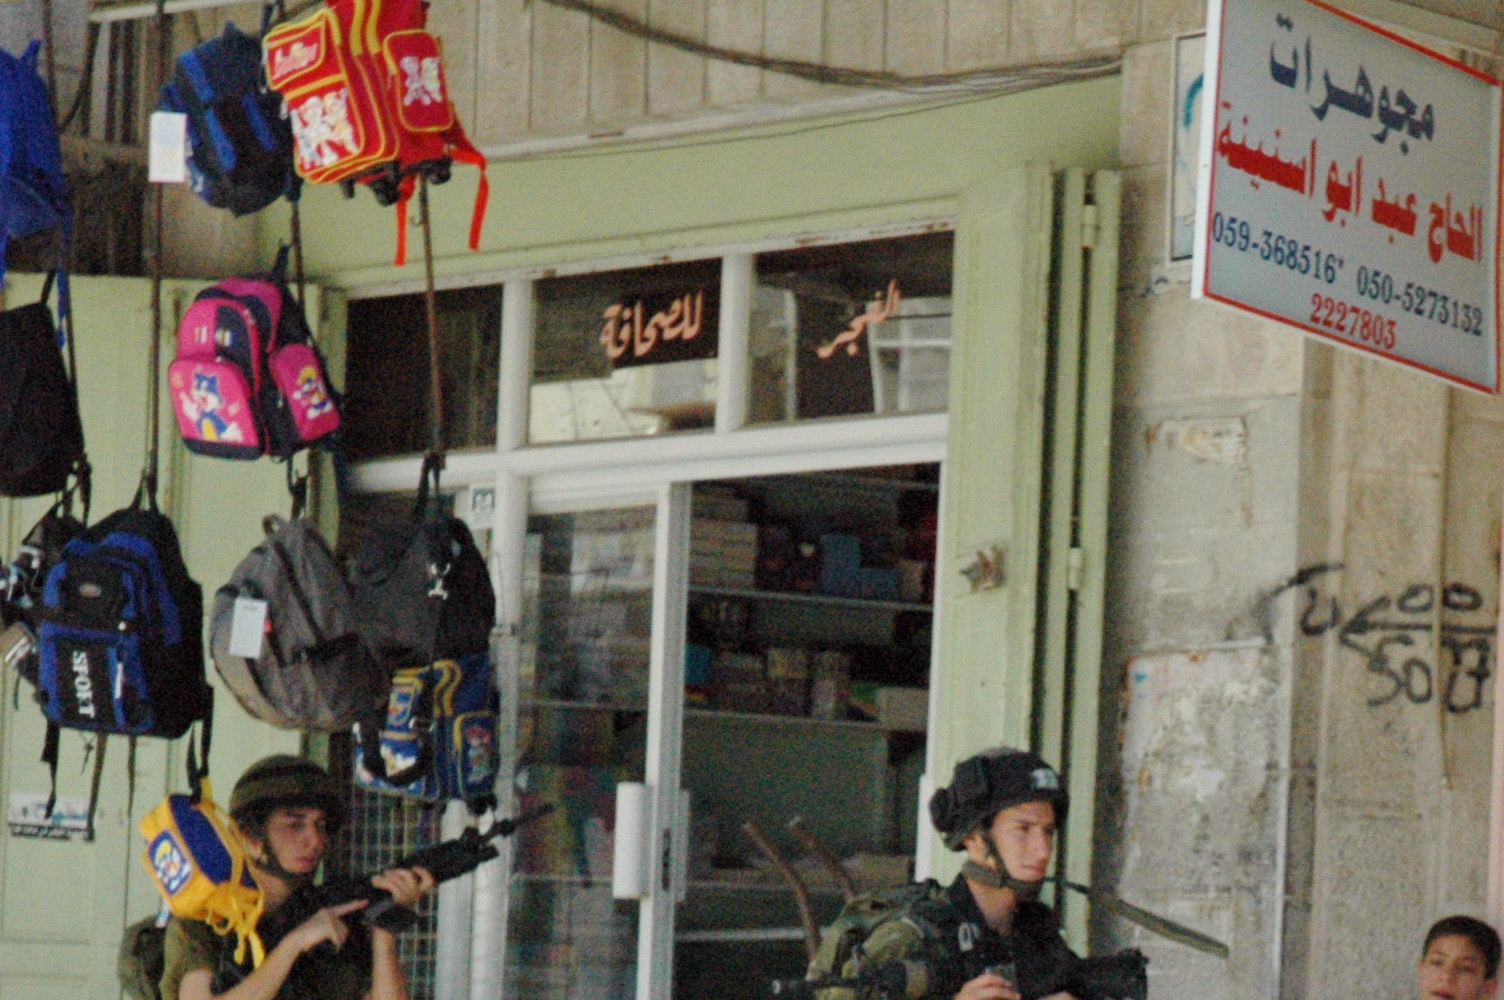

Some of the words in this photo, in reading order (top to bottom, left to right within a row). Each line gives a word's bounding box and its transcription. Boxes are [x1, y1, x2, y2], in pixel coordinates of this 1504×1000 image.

[1269, 13, 1435, 154] مجوهرات
[1322, 154, 1363, 228] ابو
[1371, 176, 1418, 244] عبد
[1426, 190, 1483, 264] الحاج
[1212, 211, 1344, 285] 059-368516
[1356, 263, 1483, 336] 050-5273132
[600, 288, 704, 360] للصحافة
[815, 277, 903, 359] الفجر
[1309, 292, 1398, 350] 2227803
[71, 649, 96, 719] SPORT
